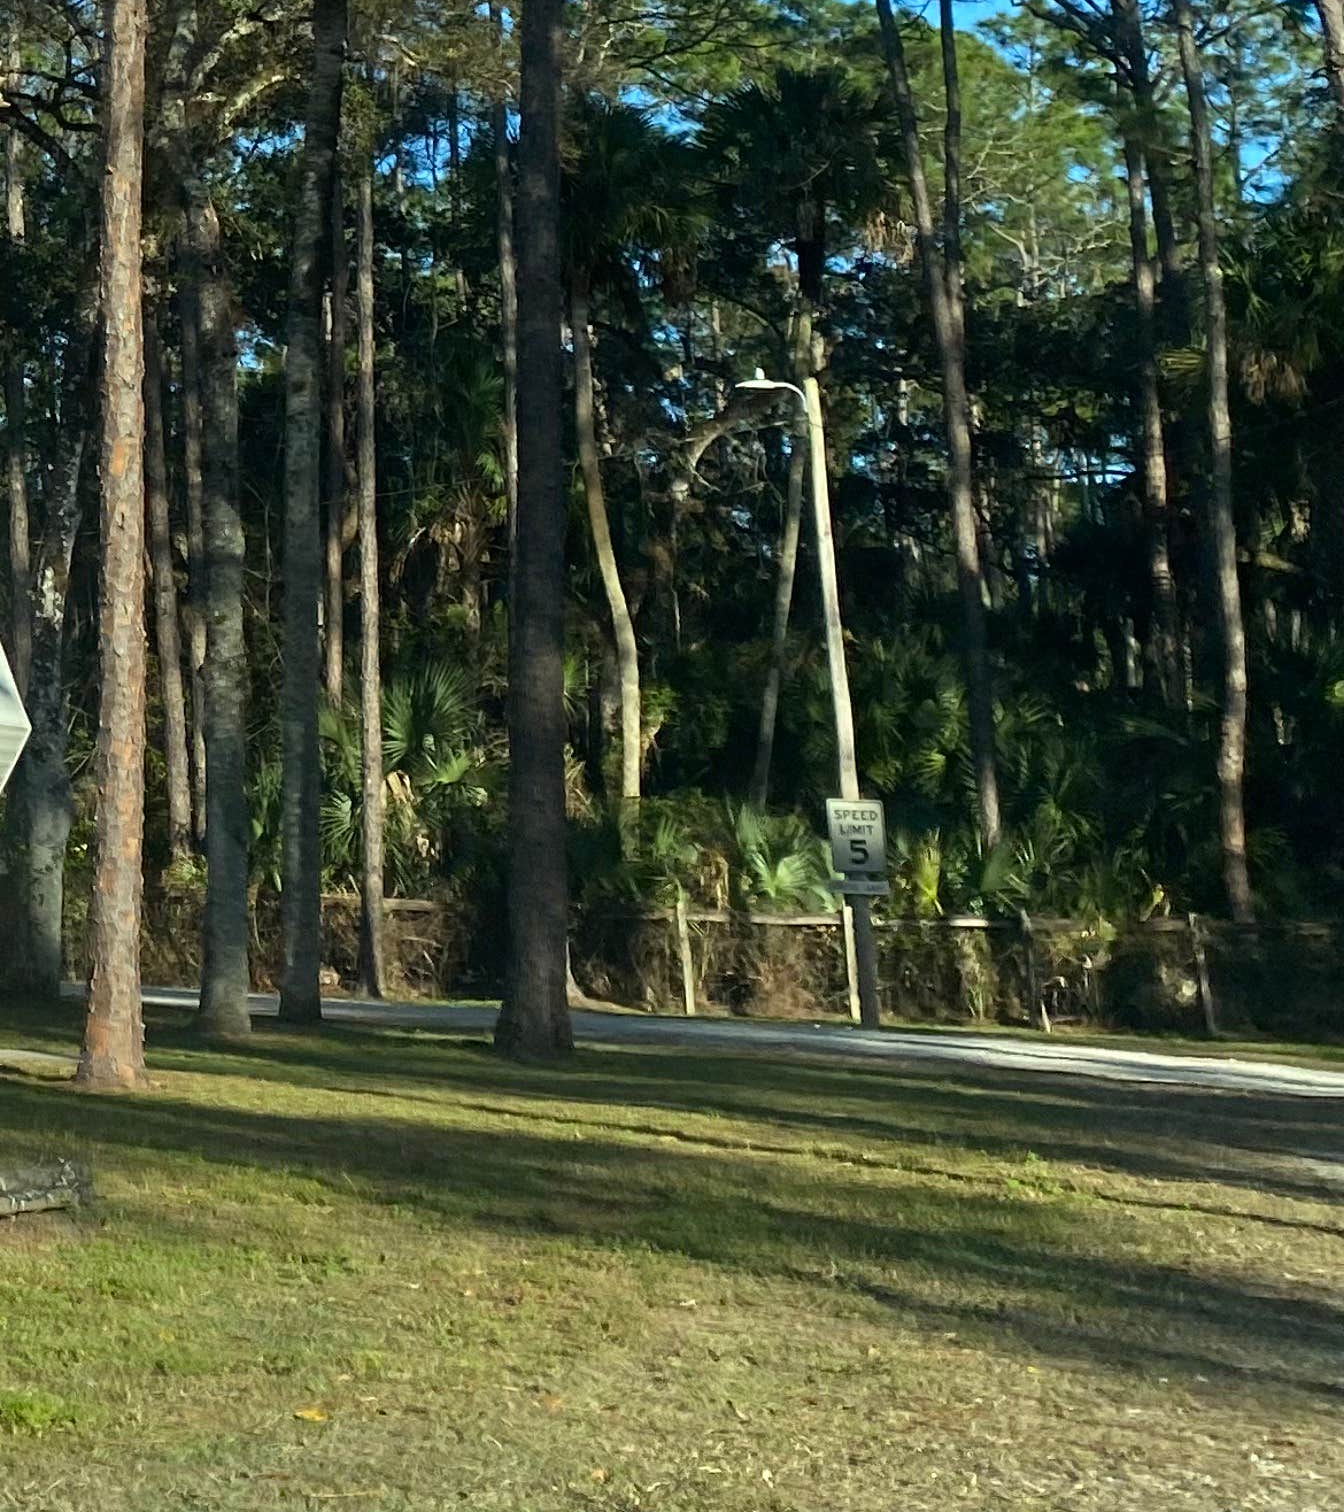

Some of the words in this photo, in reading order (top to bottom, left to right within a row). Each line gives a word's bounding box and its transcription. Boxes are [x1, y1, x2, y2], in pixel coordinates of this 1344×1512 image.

[833, 809, 879, 821] SPEED
[839, 824, 874, 836] LIMIT
[849, 839, 870, 865] 5
